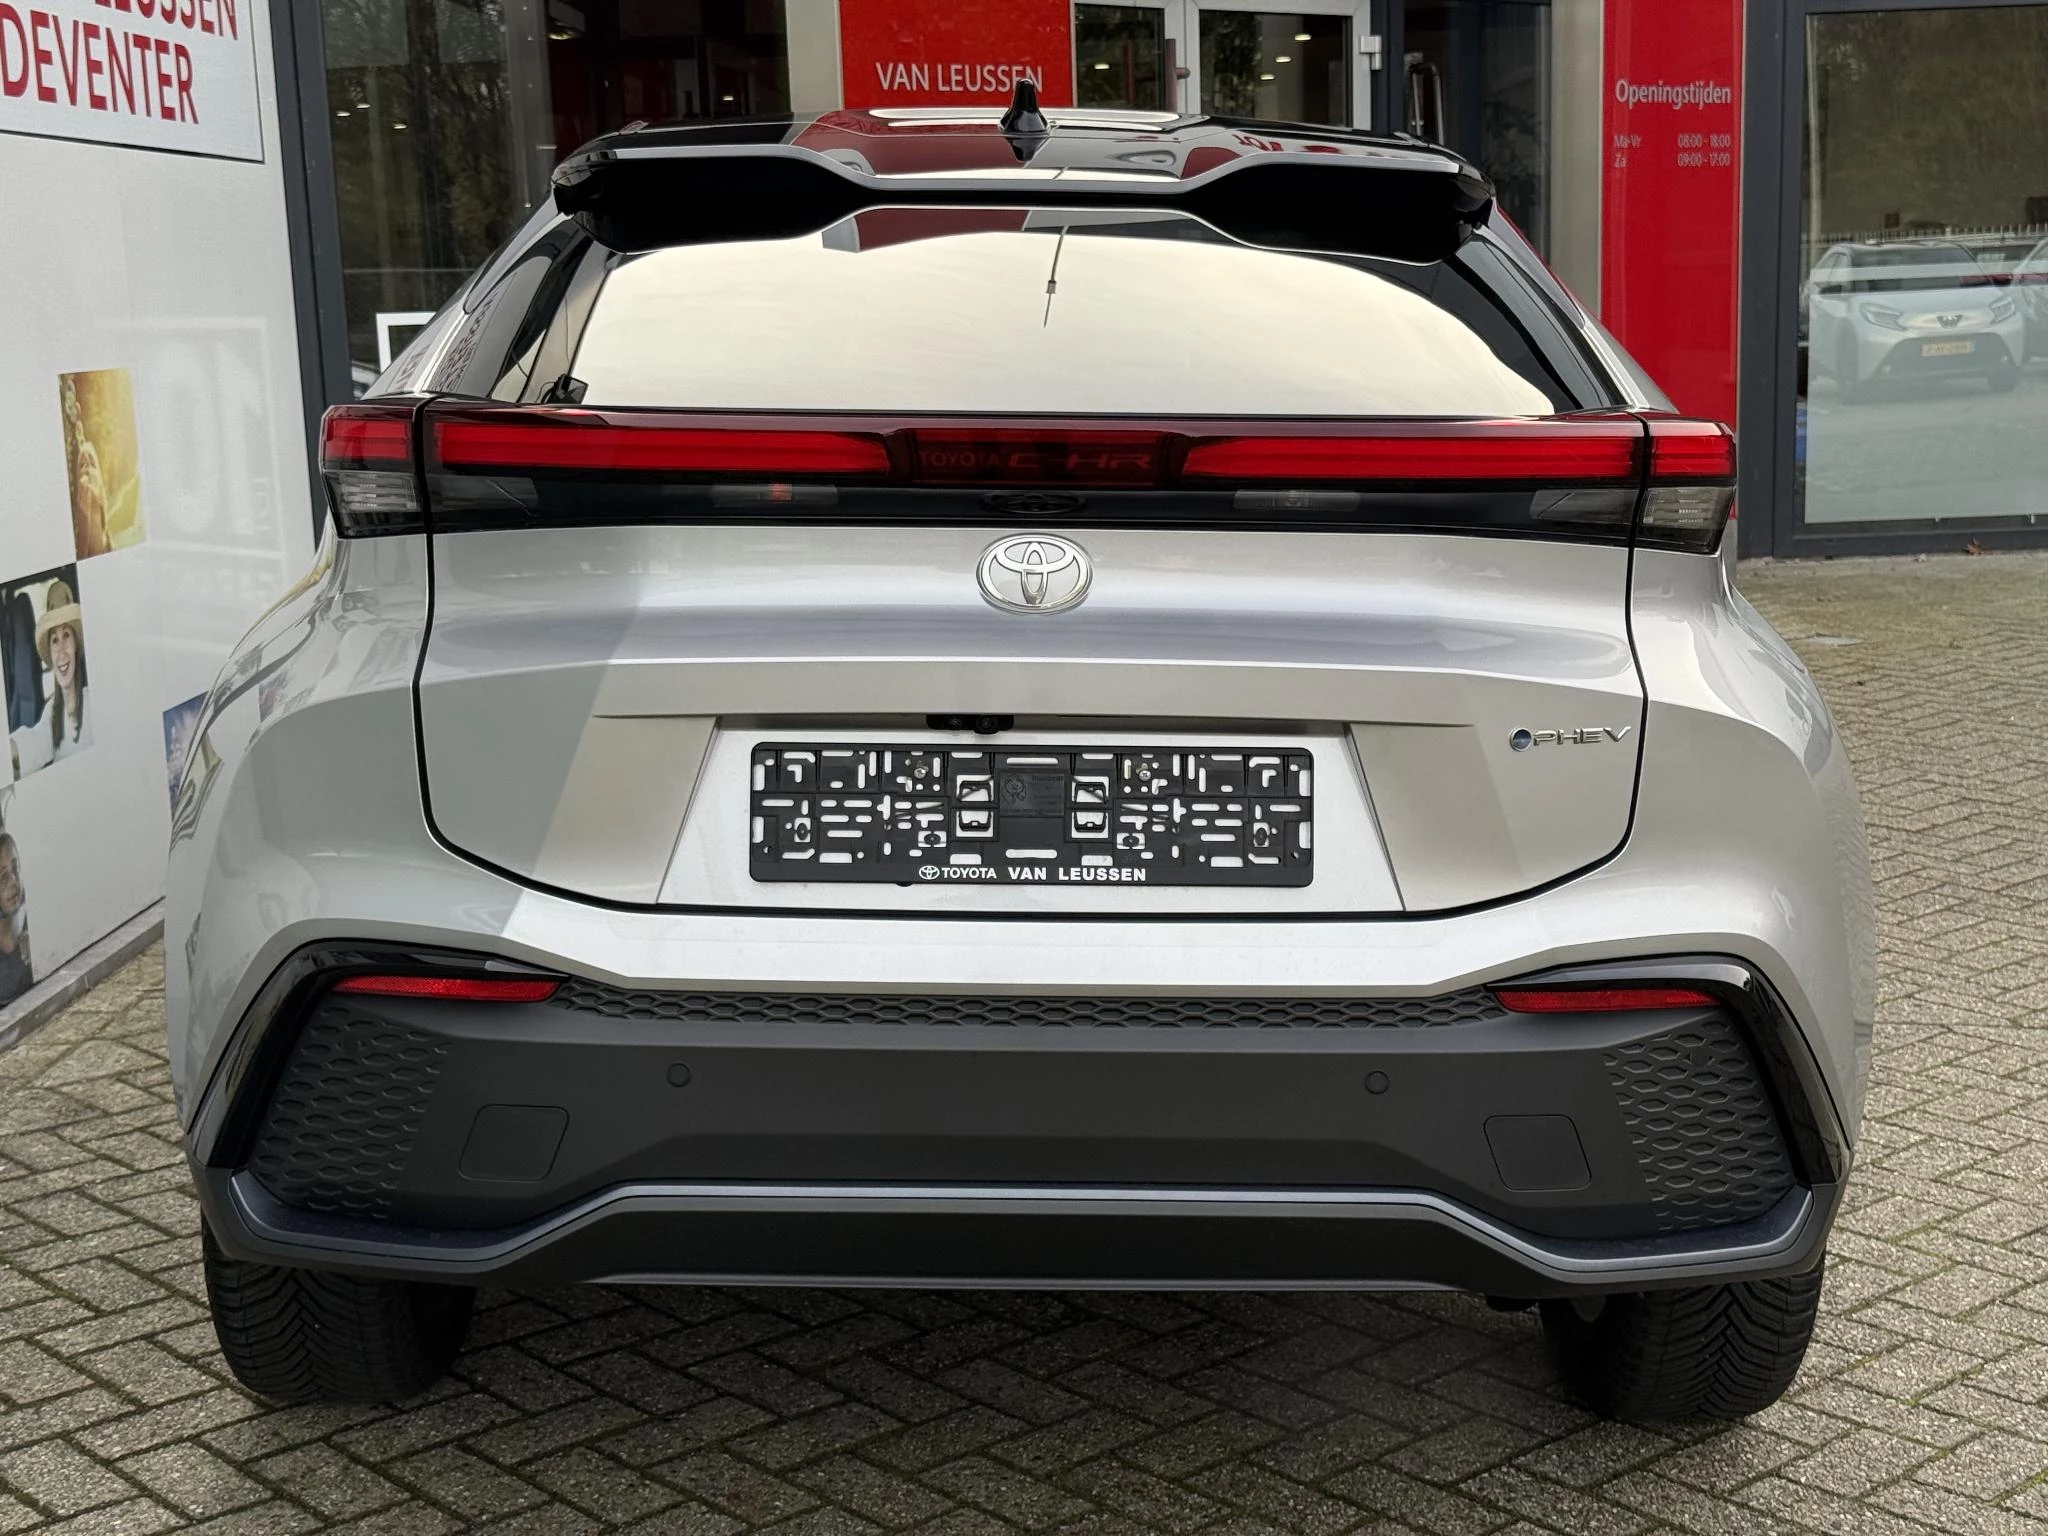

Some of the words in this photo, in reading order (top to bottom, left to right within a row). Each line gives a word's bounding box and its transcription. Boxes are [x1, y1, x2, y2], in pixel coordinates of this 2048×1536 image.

[0, 3, 199, 124] DEVENTER
[875, 62, 930, 92] VAN
[1615, 80, 1731, 109] Openingstijden
[919, 451, 1000, 468] TOYOTA
[1533, 726, 1632, 746] PHEV
[941, 867, 997, 879] TOYOTA
[1008, 867, 1047, 881] VAN
[1058, 867, 1147, 882] LEUSSEN
